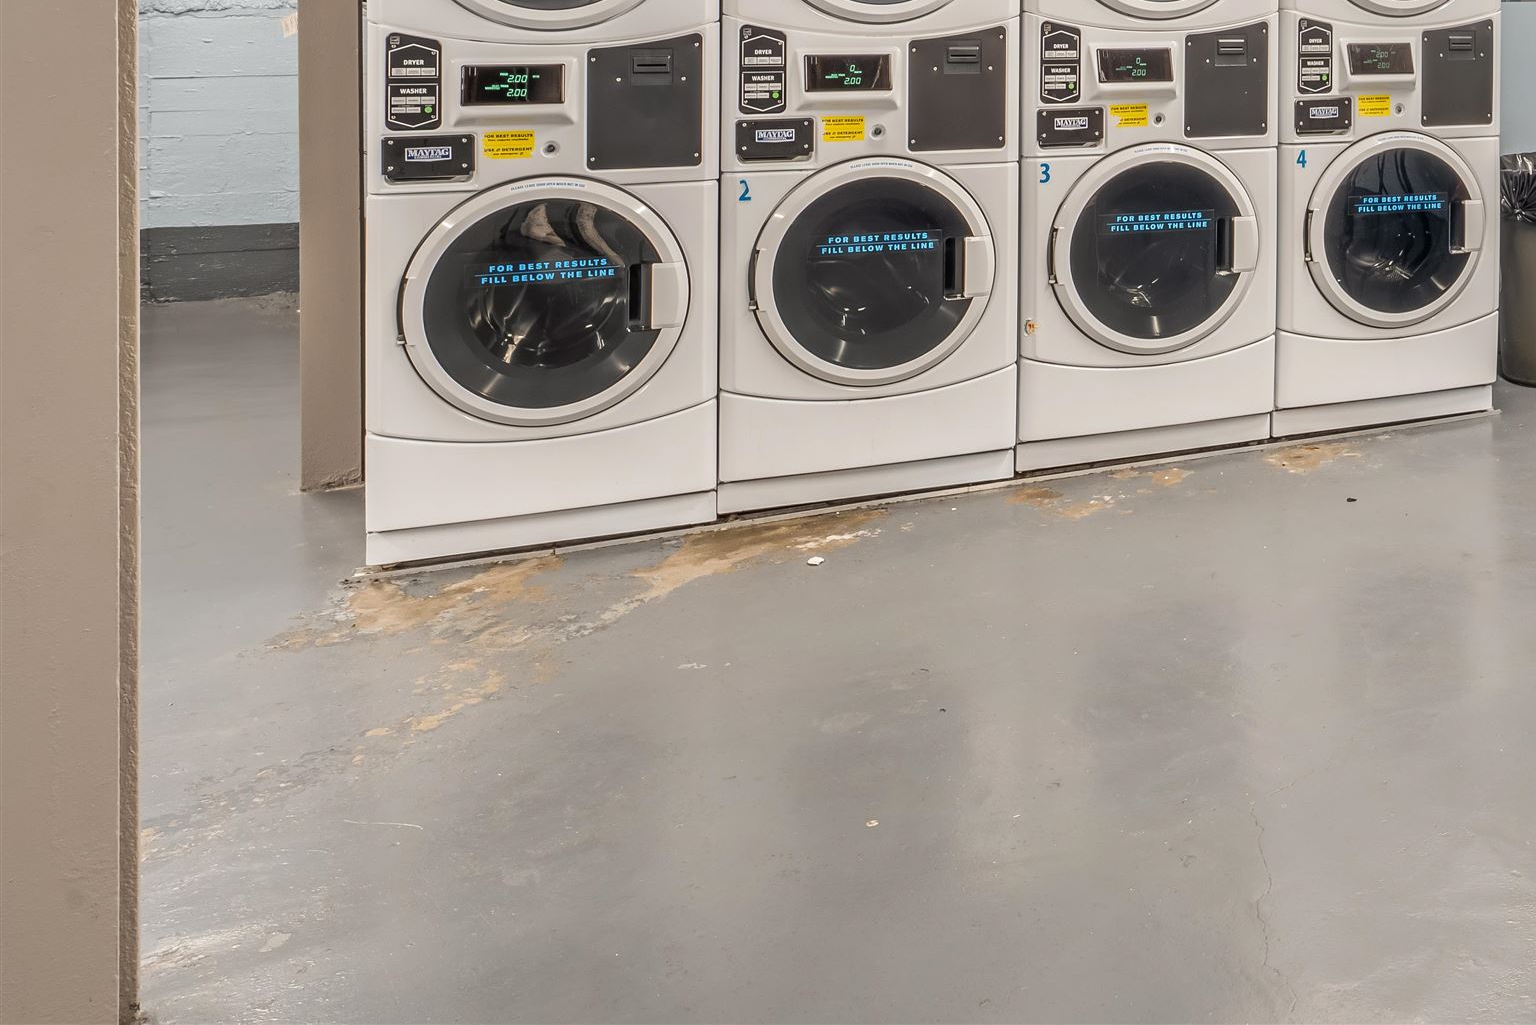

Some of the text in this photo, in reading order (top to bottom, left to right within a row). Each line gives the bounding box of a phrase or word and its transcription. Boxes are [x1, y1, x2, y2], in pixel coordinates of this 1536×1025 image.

[507, 75, 528, 83] 2.00
[507, 89, 527, 97] 2.00
[758, 131, 793, 139] MAYTAG
[407, 147, 449, 157] MAYTAG
[1296, 150, 1307, 168] 4
[1040, 163, 1050, 183] 3
[738, 180, 752, 201] 2
[1164, 212, 1202, 220] RESULTS
[884, 232, 928, 241] RESULTS
[848, 245, 883, 253] BELOW
[489, 258, 607, 273] FOR BEST RESULTS
[512, 273, 555, 283] BELOW
[560, 271, 582, 279] THE
[588, 269, 615, 277] LINE
